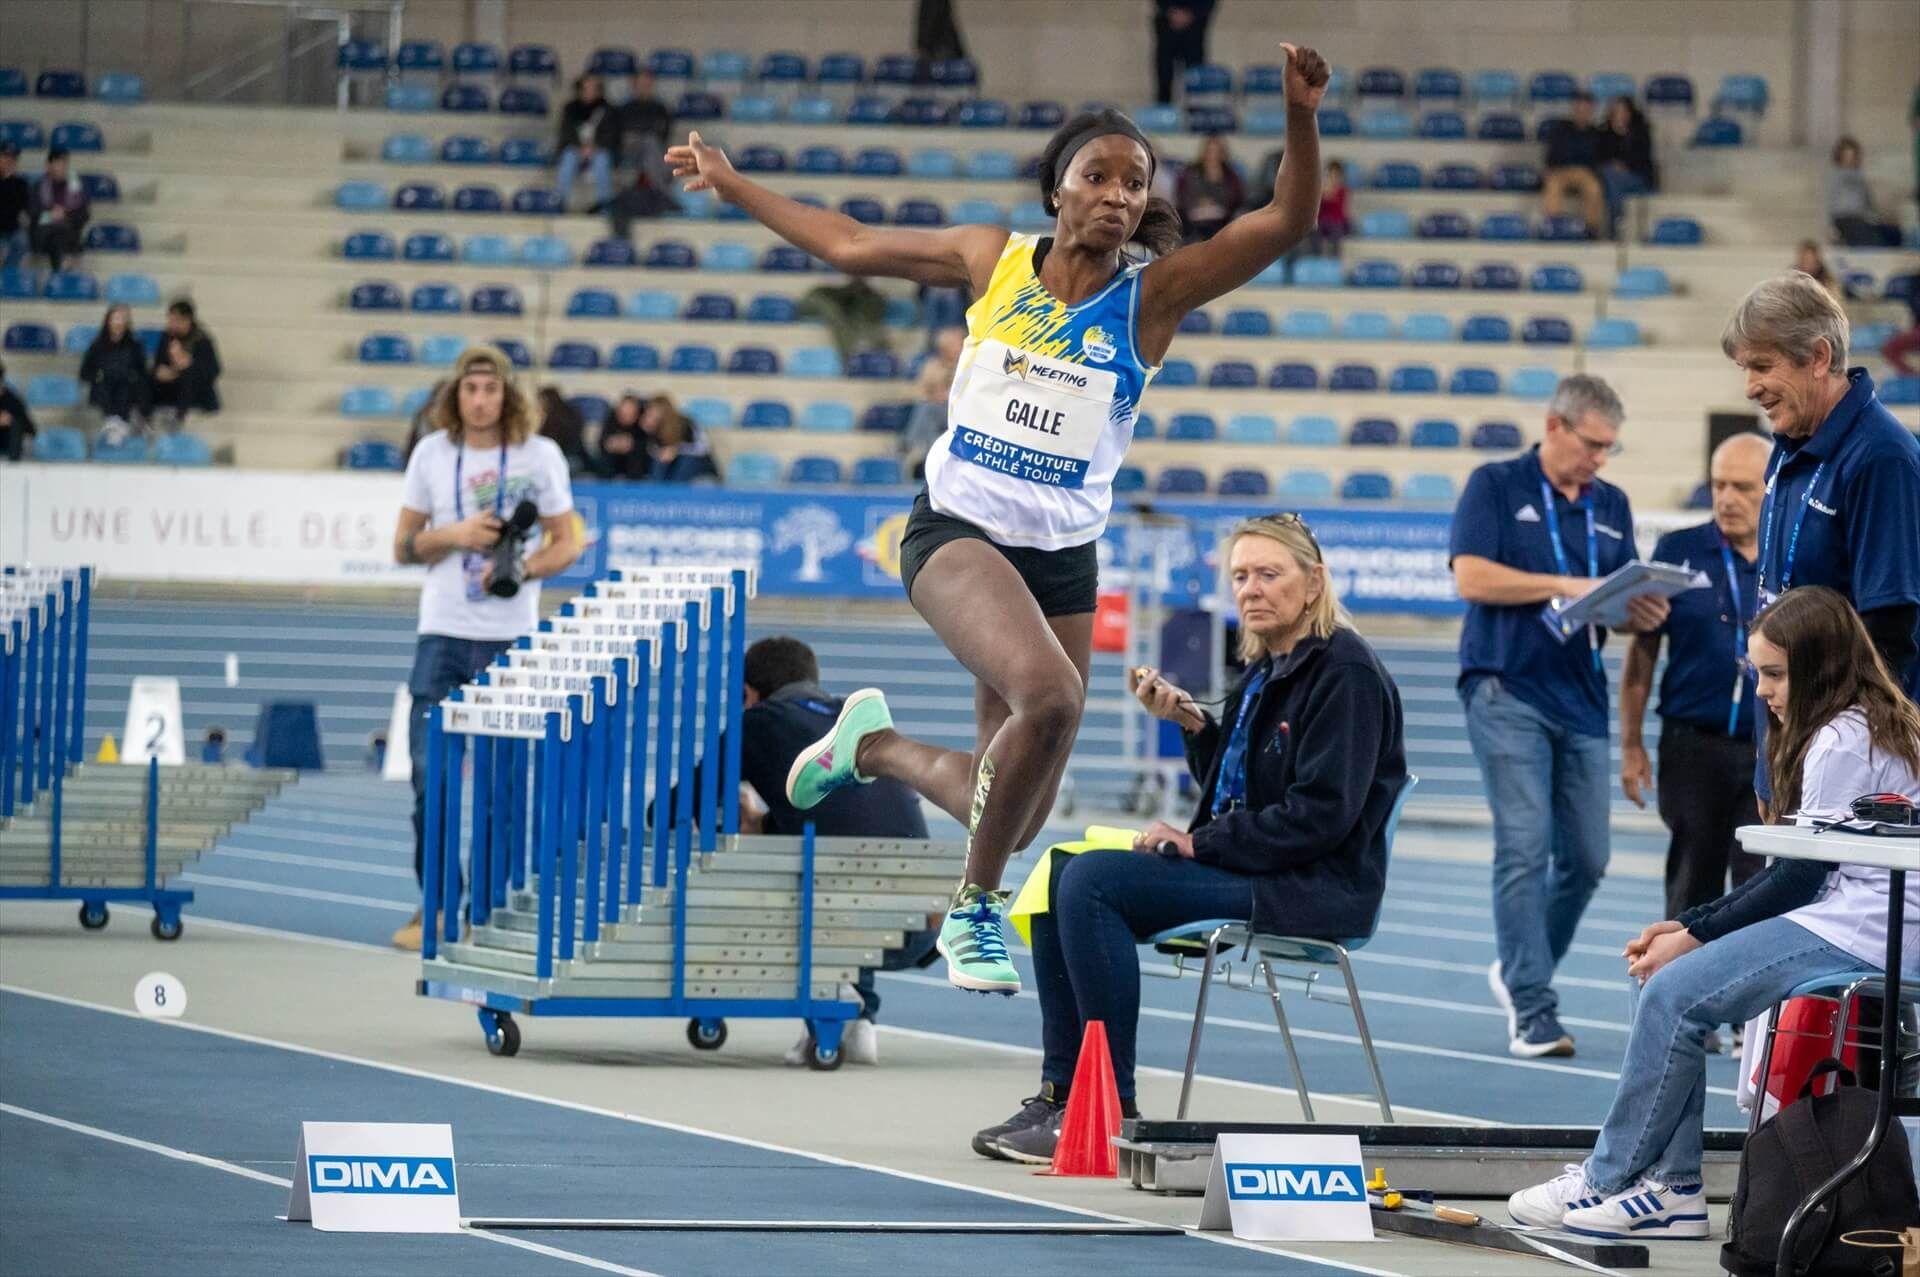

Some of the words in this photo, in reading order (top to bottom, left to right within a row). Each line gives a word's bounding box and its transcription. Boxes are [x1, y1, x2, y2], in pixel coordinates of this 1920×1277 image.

[1030, 364, 1087, 387] MEETING
[1005, 399, 1065, 436] GALLE
[963, 431, 1018, 458] CRÉDIT
[1020, 451, 1079, 473] MUTUEL
[974, 451, 1020, 474] ATHLÉ
[1023, 466, 1061, 484] TOUR
[50, 507, 132, 545] UNE
[300, 511, 378, 551] DES
[146, 712, 167, 751] 2
[154, 985, 166, 1007] 8
[314, 1161, 449, 1189] DIMA
[1231, 1169, 1360, 1196] DIMA
